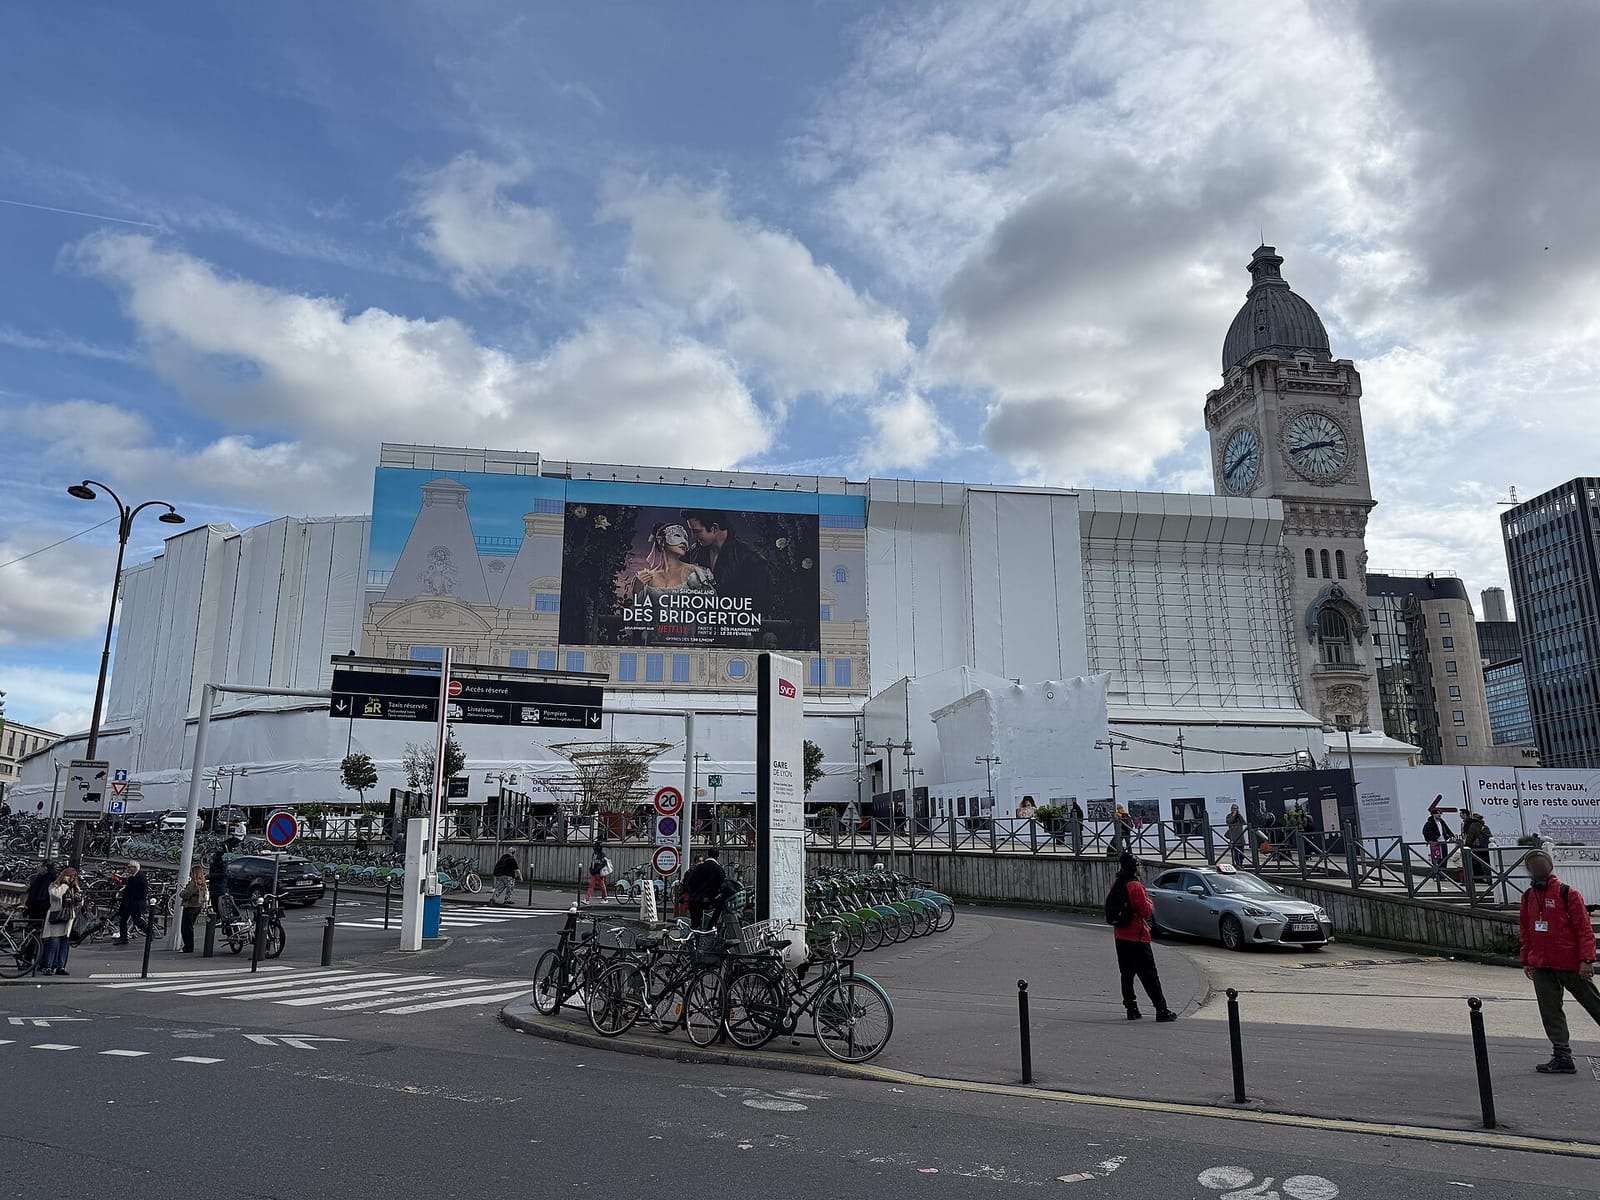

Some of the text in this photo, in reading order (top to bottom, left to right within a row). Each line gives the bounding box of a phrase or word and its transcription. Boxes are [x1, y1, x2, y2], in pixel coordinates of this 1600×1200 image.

[634, 593, 752, 611] LA CHRONIQUE
[623, 608, 762, 625] DES BRIDGERTON
[658, 625, 689, 634] NETFLIX
[465, 685, 484, 693] Accès
[780, 686, 795, 696] SNCF
[403, 702, 428, 710] réservés
[773, 760, 788, 769] GARE
[780, 770, 793, 778] LYON
[1479, 779, 1588, 793] Pendant les travaux,
[661, 795, 678, 808] 20
[1481, 796, 1509, 806] votre
[1512, 798, 1540, 809] gare
[1542, 797, 1569, 807] reste
